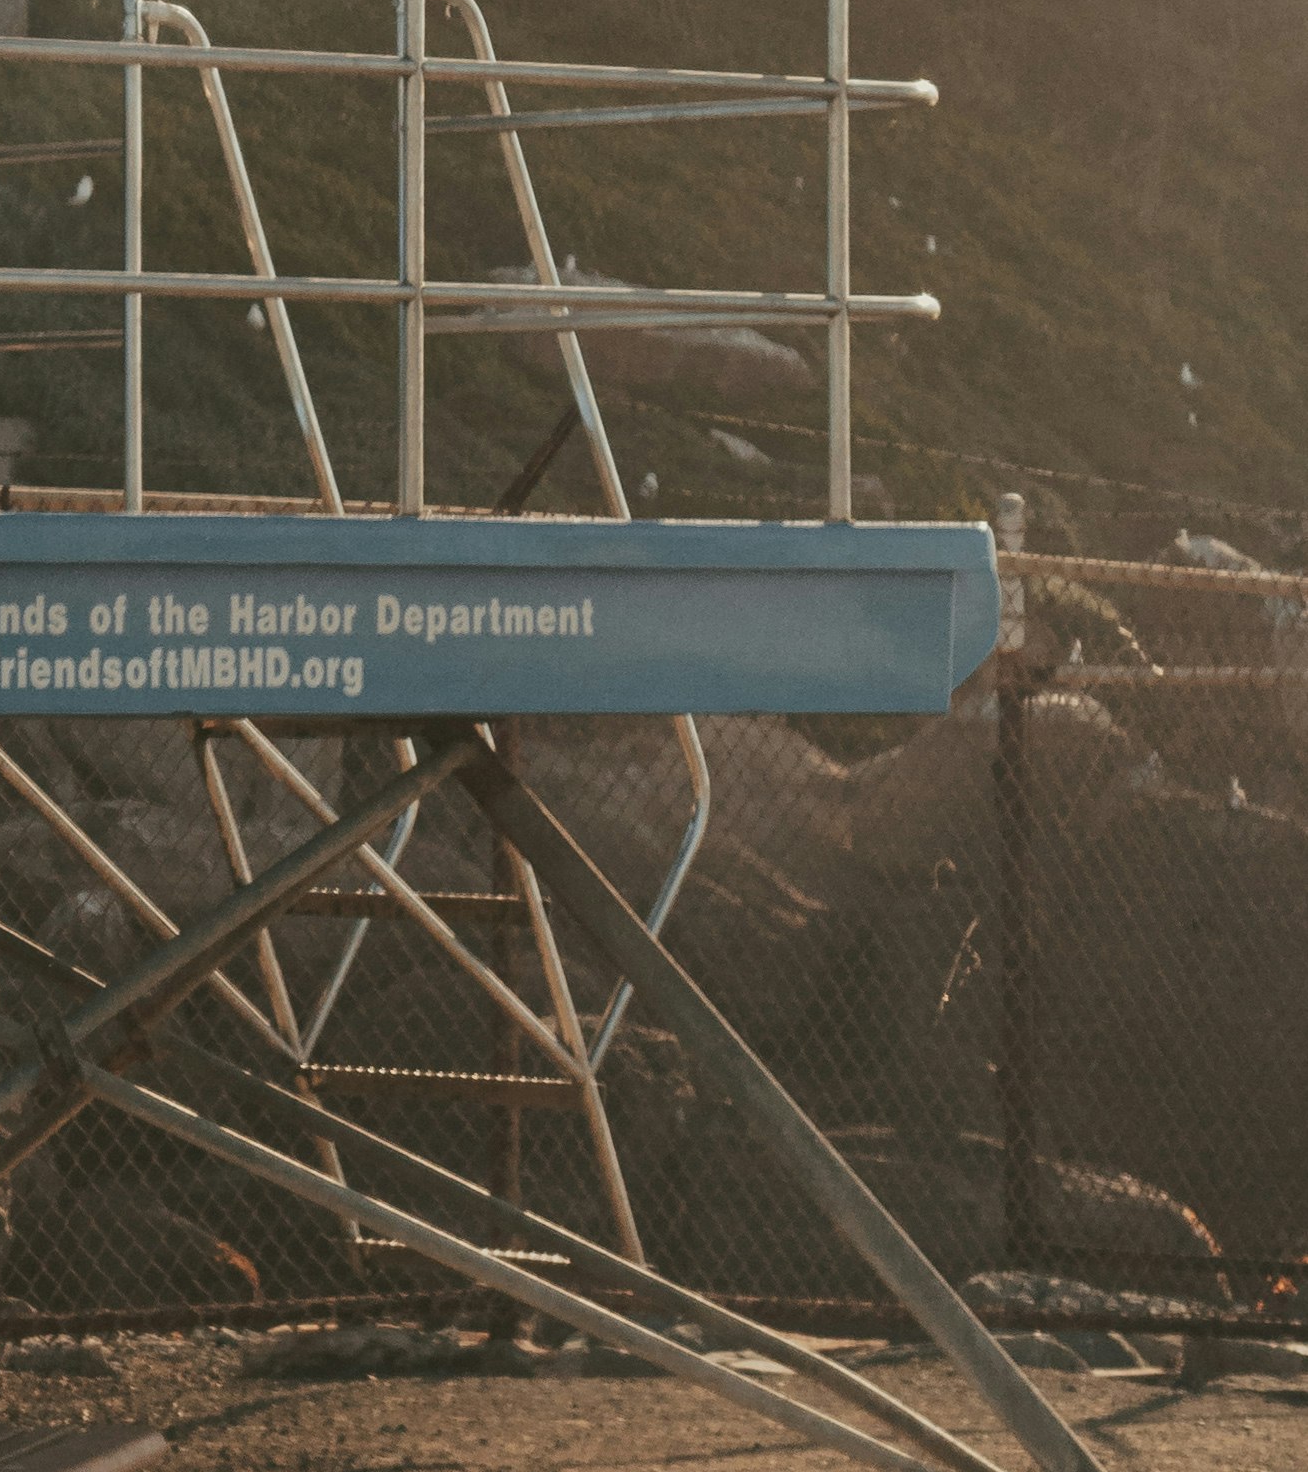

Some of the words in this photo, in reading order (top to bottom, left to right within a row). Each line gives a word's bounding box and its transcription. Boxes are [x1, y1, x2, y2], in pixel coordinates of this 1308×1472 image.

[90, 595, 126, 635] of
[149, 595, 209, 635] the
[230, 595, 357, 635] Harbor
[377, 595, 594, 642] Department
